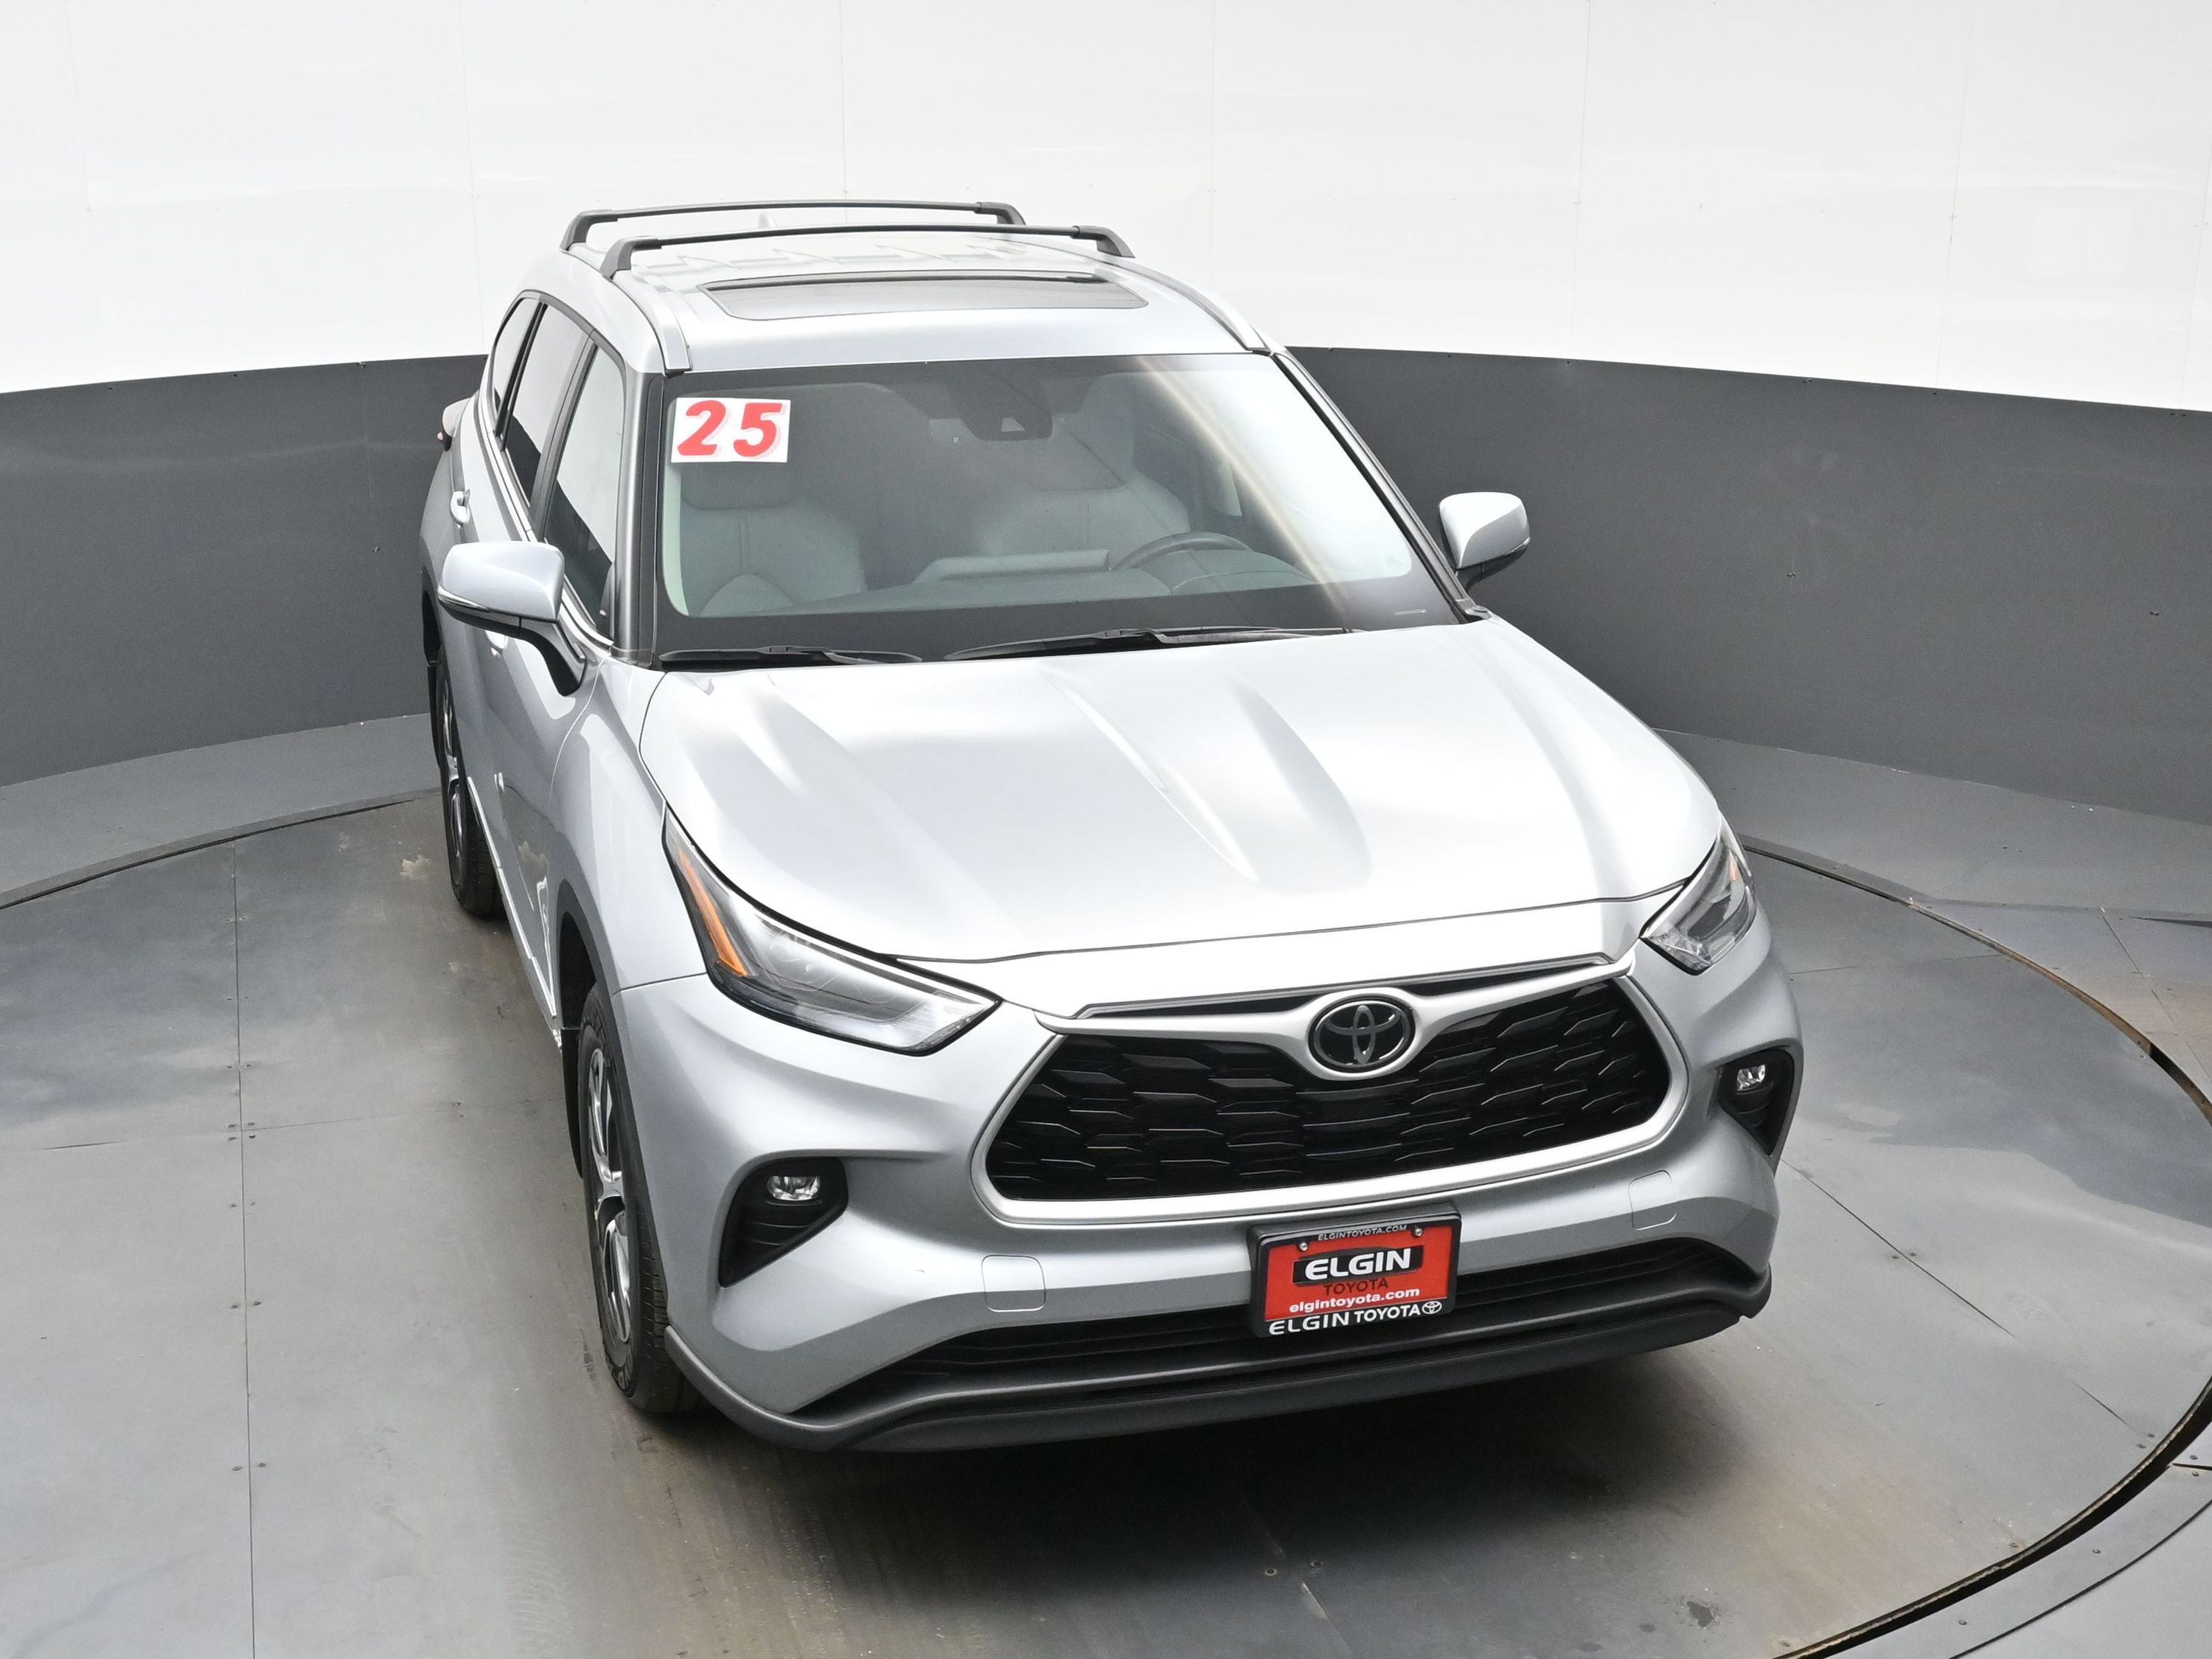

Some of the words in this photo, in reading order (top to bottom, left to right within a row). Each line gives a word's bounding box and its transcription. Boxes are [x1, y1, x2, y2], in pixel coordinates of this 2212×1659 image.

[677, 400, 784, 458] 25
[1318, 1225, 1407, 1241] ELGINTOYOTA.COM
[1305, 1248, 1411, 1280] ELGIN
[1290, 1288, 1420, 1313] elgintoyota.com
[1324, 1278, 1388, 1295] TOYOTA
[1269, 1312, 1349, 1335] ELGIN
[1354, 1304, 1420, 1323] TOYOTA
